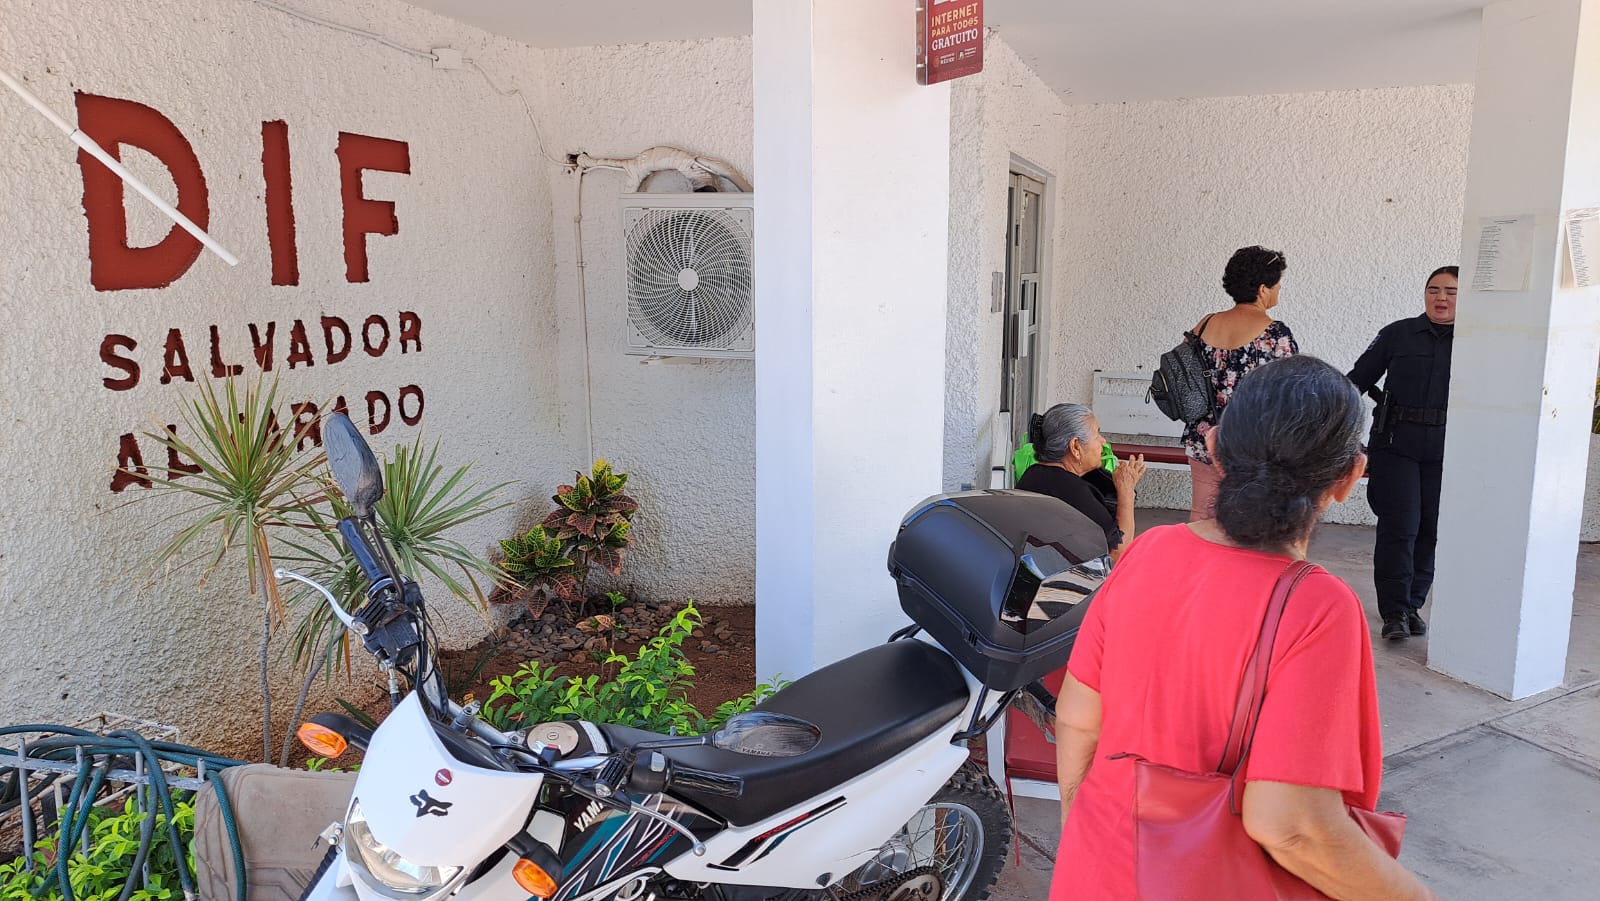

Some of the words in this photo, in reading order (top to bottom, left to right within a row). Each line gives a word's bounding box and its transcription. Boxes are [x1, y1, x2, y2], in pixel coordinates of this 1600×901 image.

[931, 2, 978, 27] INTERNET
[931, 25, 951, 38] PARA
[931, 28, 979, 51] GRATUITO
[74, 90, 411, 292] DIF
[99, 311, 422, 391] SALVADOR
